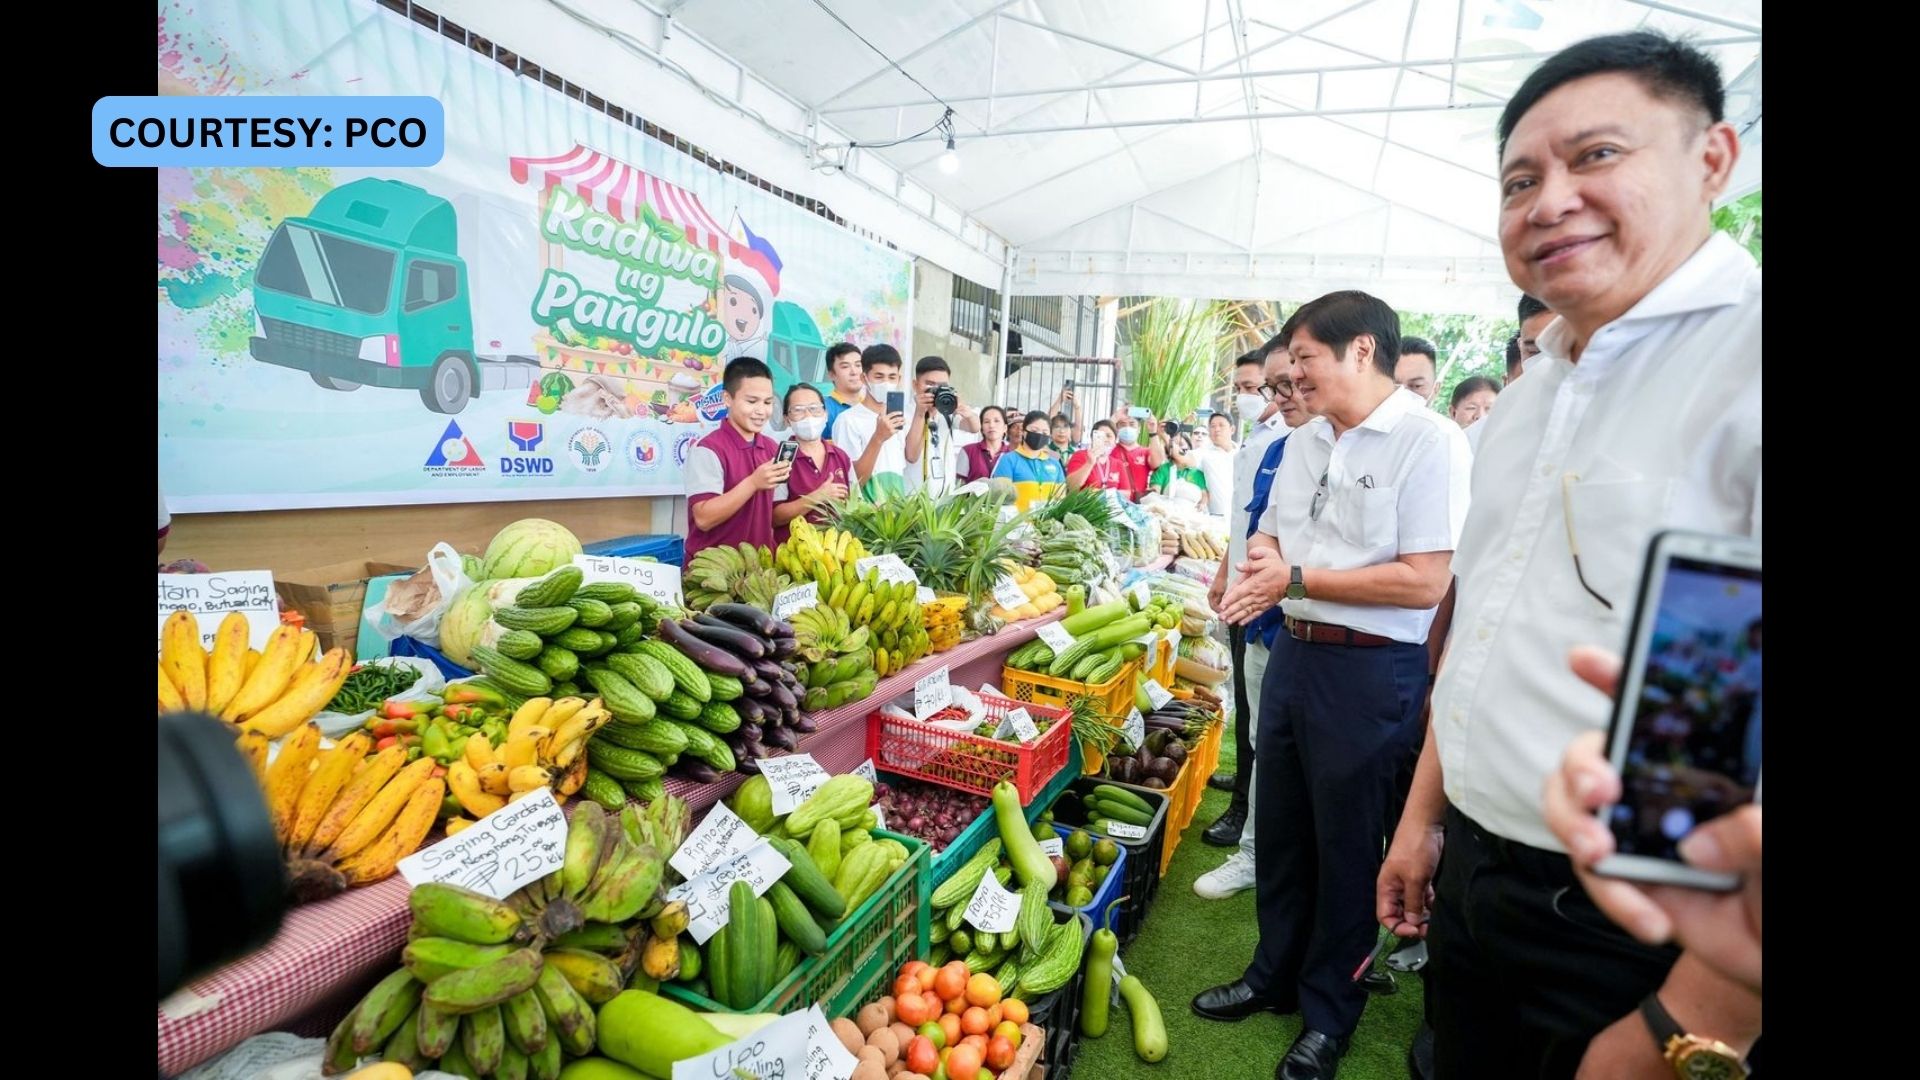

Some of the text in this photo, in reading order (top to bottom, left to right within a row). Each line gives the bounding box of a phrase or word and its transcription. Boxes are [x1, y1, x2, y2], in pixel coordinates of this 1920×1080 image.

[546, 189, 718, 282] Kadiwa
[620, 266, 660, 300] ng
[536, 272, 726, 349] Pangulo
[500, 457, 554, 474] DSWD
[158, 577, 269, 601] tan Saging
[586, 558, 654, 586] Talong
[421, 830, 498, 871] Saging
[683, 827, 718, 861] Pipino
[712, 1041, 766, 1079] Upo
